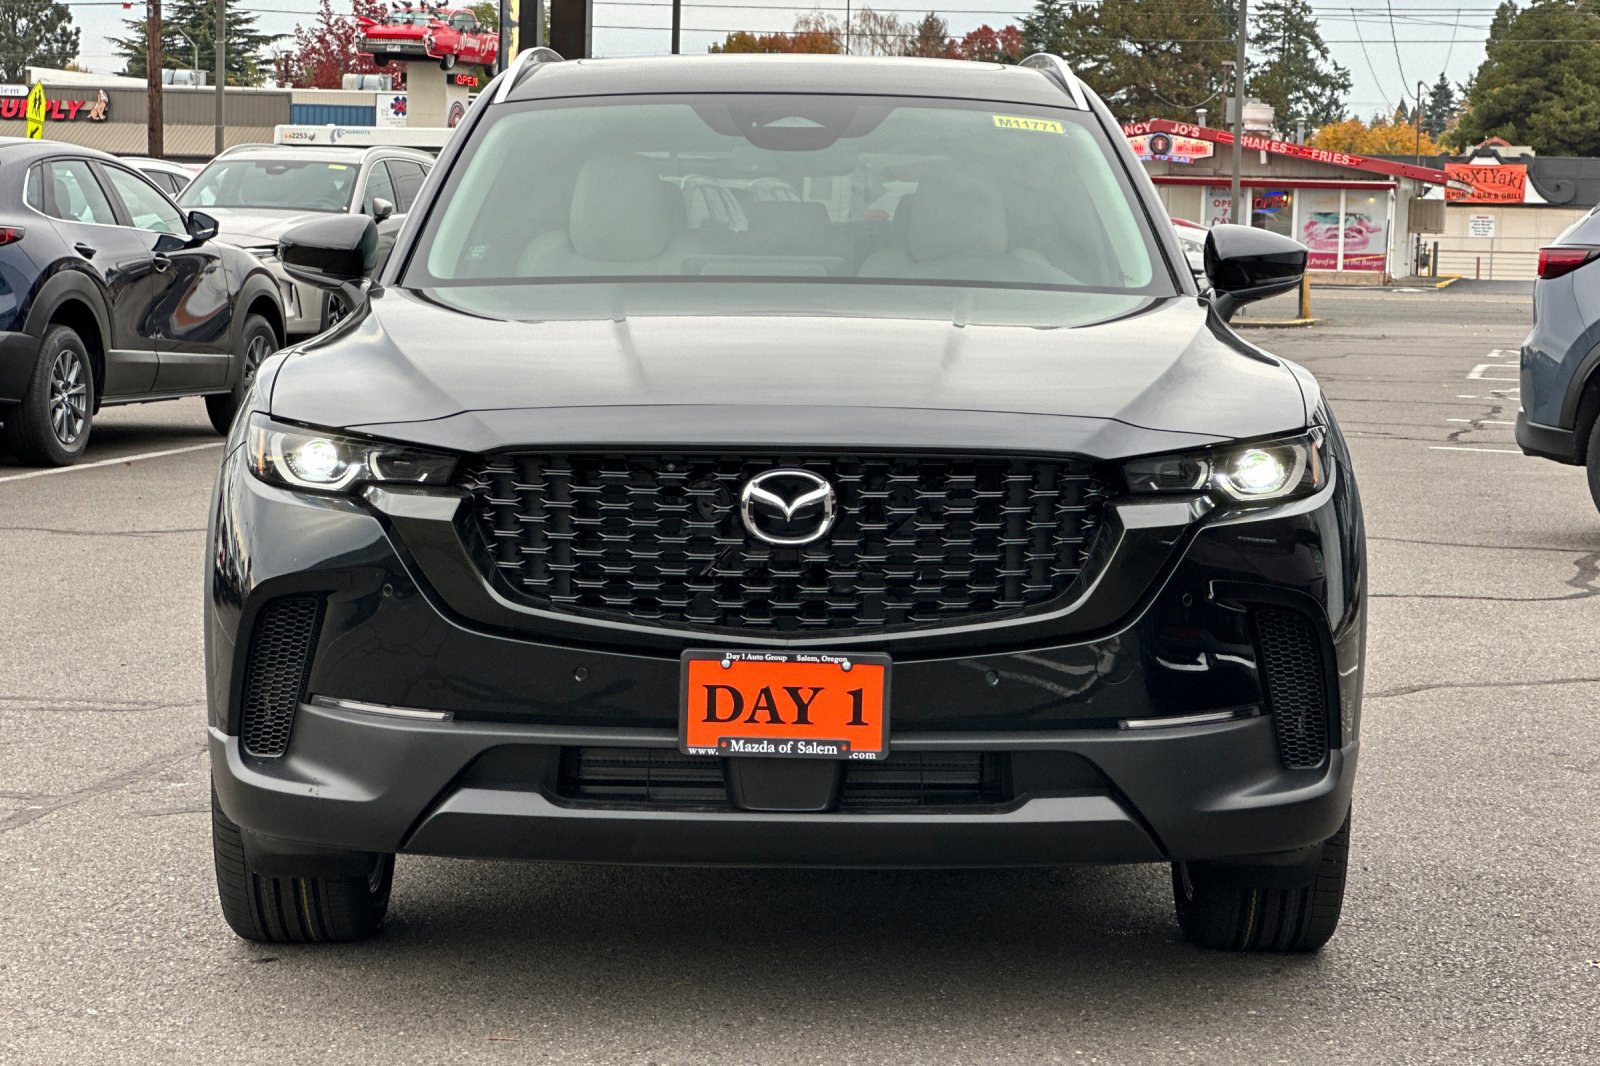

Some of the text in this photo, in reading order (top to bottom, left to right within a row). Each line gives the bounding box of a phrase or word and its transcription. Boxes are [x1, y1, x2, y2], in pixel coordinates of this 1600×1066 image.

[456, 74, 478, 87] OPEN
[0, 86, 20, 95] lem
[998, 118, 1058, 132] M11771
[1124, 122, 1200, 137] NCY JO'S
[1311, 149, 1350, 165] FRIES
[1213, 199, 1232, 208] OPE
[1253, 195, 1288, 209] OPEN
[726, 652, 740, 661] Day
[746, 653, 764, 661] Auto
[765, 653, 787, 662] Group
[796, 654, 820, 663] Salem,
[821, 655, 848, 664] Oregon
[702, 684, 869, 726] DAY 1
[688, 739, 876, 760] www. Mazda of Salem .com
